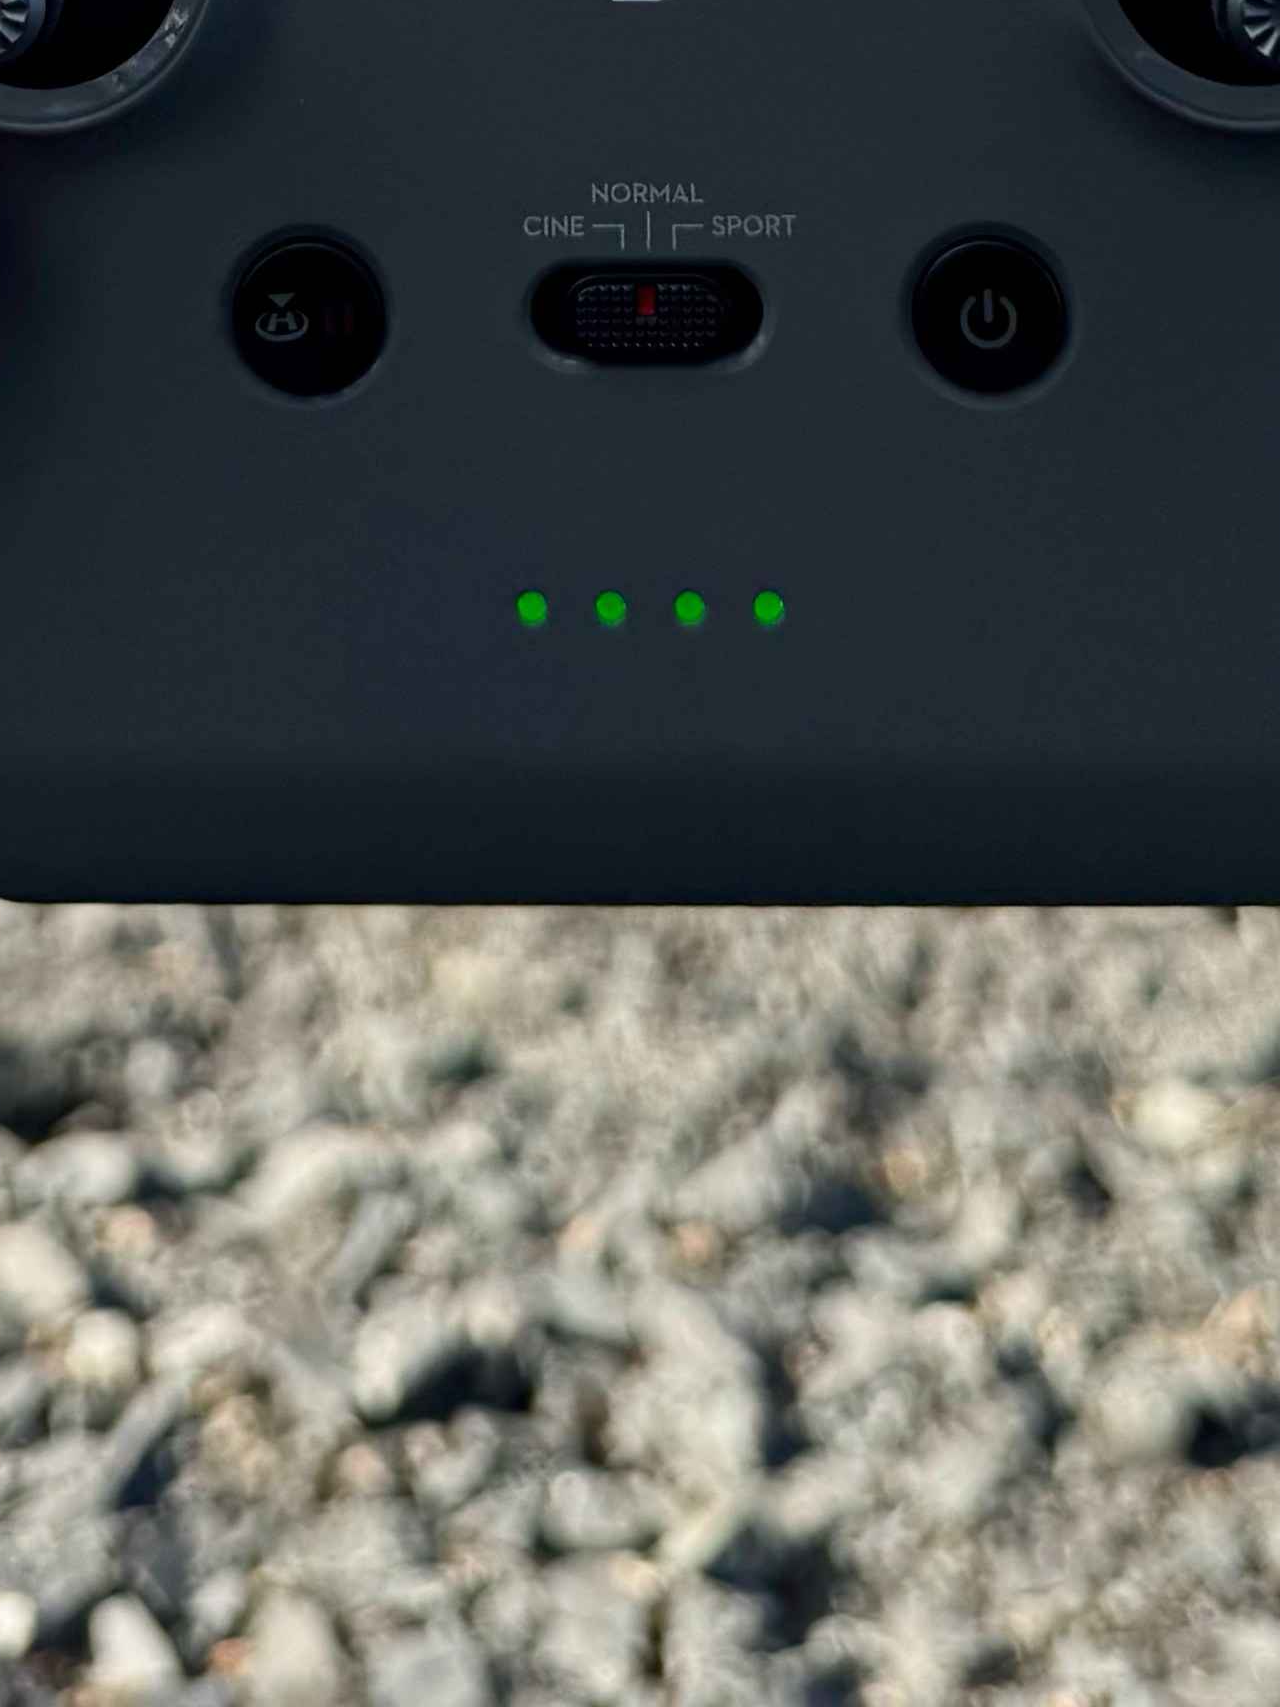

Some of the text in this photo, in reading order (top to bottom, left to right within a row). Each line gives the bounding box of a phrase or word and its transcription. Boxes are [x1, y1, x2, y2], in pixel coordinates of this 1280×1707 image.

[591, 183, 704, 204] NORMAL
[523, 215, 585, 237] CINE
[711, 214, 797, 237] SPORT
